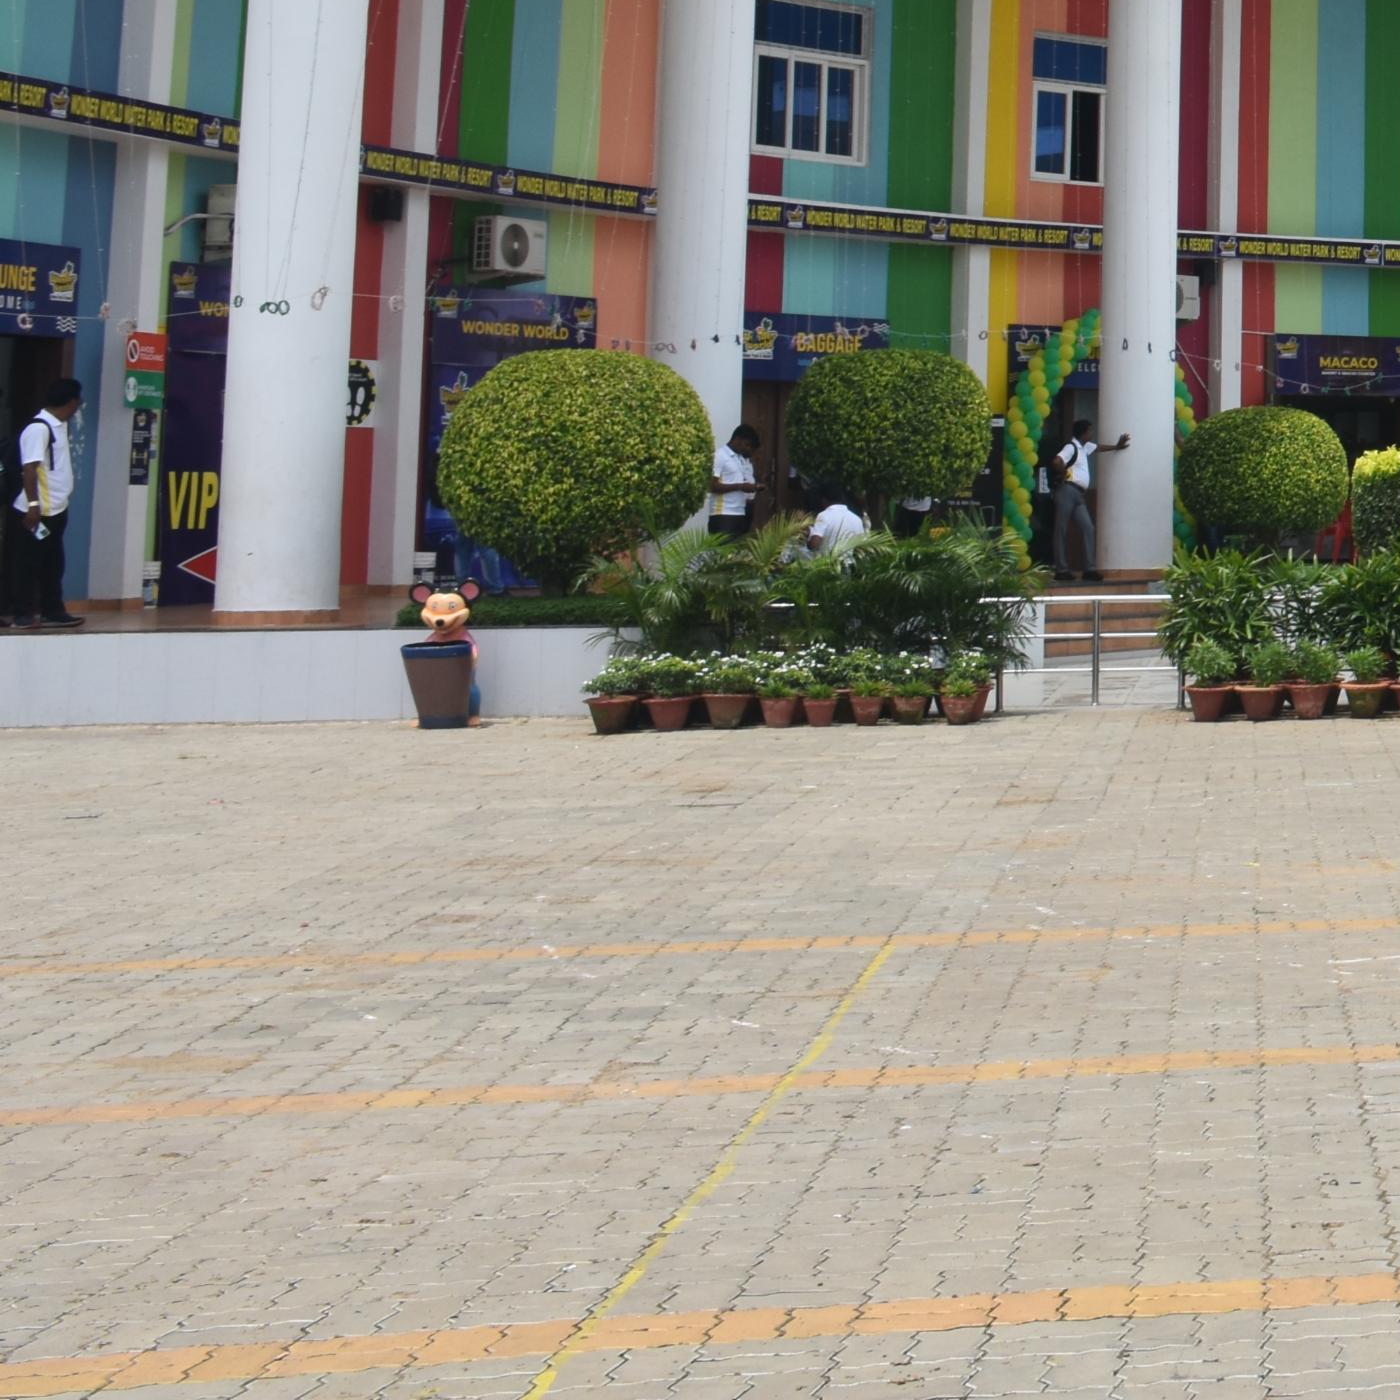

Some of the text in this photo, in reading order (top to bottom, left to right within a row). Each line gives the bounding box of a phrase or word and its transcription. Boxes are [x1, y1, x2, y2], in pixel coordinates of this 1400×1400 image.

[19, 84, 47, 108] RESORT
[71, 94, 99, 118] WONDER
[100, 100, 123, 123] WORLD
[124, 105, 147, 126] WATER
[147, 109, 165, 130] PARK
[172, 114, 199, 137] RESORT
[367, 151, 394, 172] WONDER
[395, 155, 418, 175] WORLD
[418, 159, 441, 179] WATER
[442, 163, 461, 182] PARK
[466, 167, 493, 187] RESORT
[517, 175, 543, 194] WONDER
[544, 180, 566, 198] WORLD
[567, 183, 588, 200] WATER
[589, 185, 607, 203] PARK
[613, 189, 639, 208] RESORT
[757, 206, 781, 222] RESORT
[806, 209, 833, 227] WONDER
[834, 212, 854, 229] WORLD
[856, 215, 877, 230] WATER
[879, 216, 896, 232] PARK
[902, 219, 927, 234] RESORT
[950, 223, 976, 238] WONDER
[977, 225, 998, 239] WORLD
[999, 227, 1020, 242] WATER
[1020, 228, 1037, 243] PARK
[1044, 230, 1068, 244] RESORT
[1189, 238, 1213, 252] RESORT
[1239, 241, 1265, 255] WONDER
[1267, 242, 1288, 256] WORLD
[1290, 243, 1312, 257] WATER
[1313, 244, 1329, 258] PARK
[1337, 246, 1361, 260] RESORT
[462, 320, 569, 341] WONDER WORLD
[796, 332, 863, 353] BAGGAGE
[1319, 357, 1378, 369] MACACO
[168, 471, 219, 529] VIP
